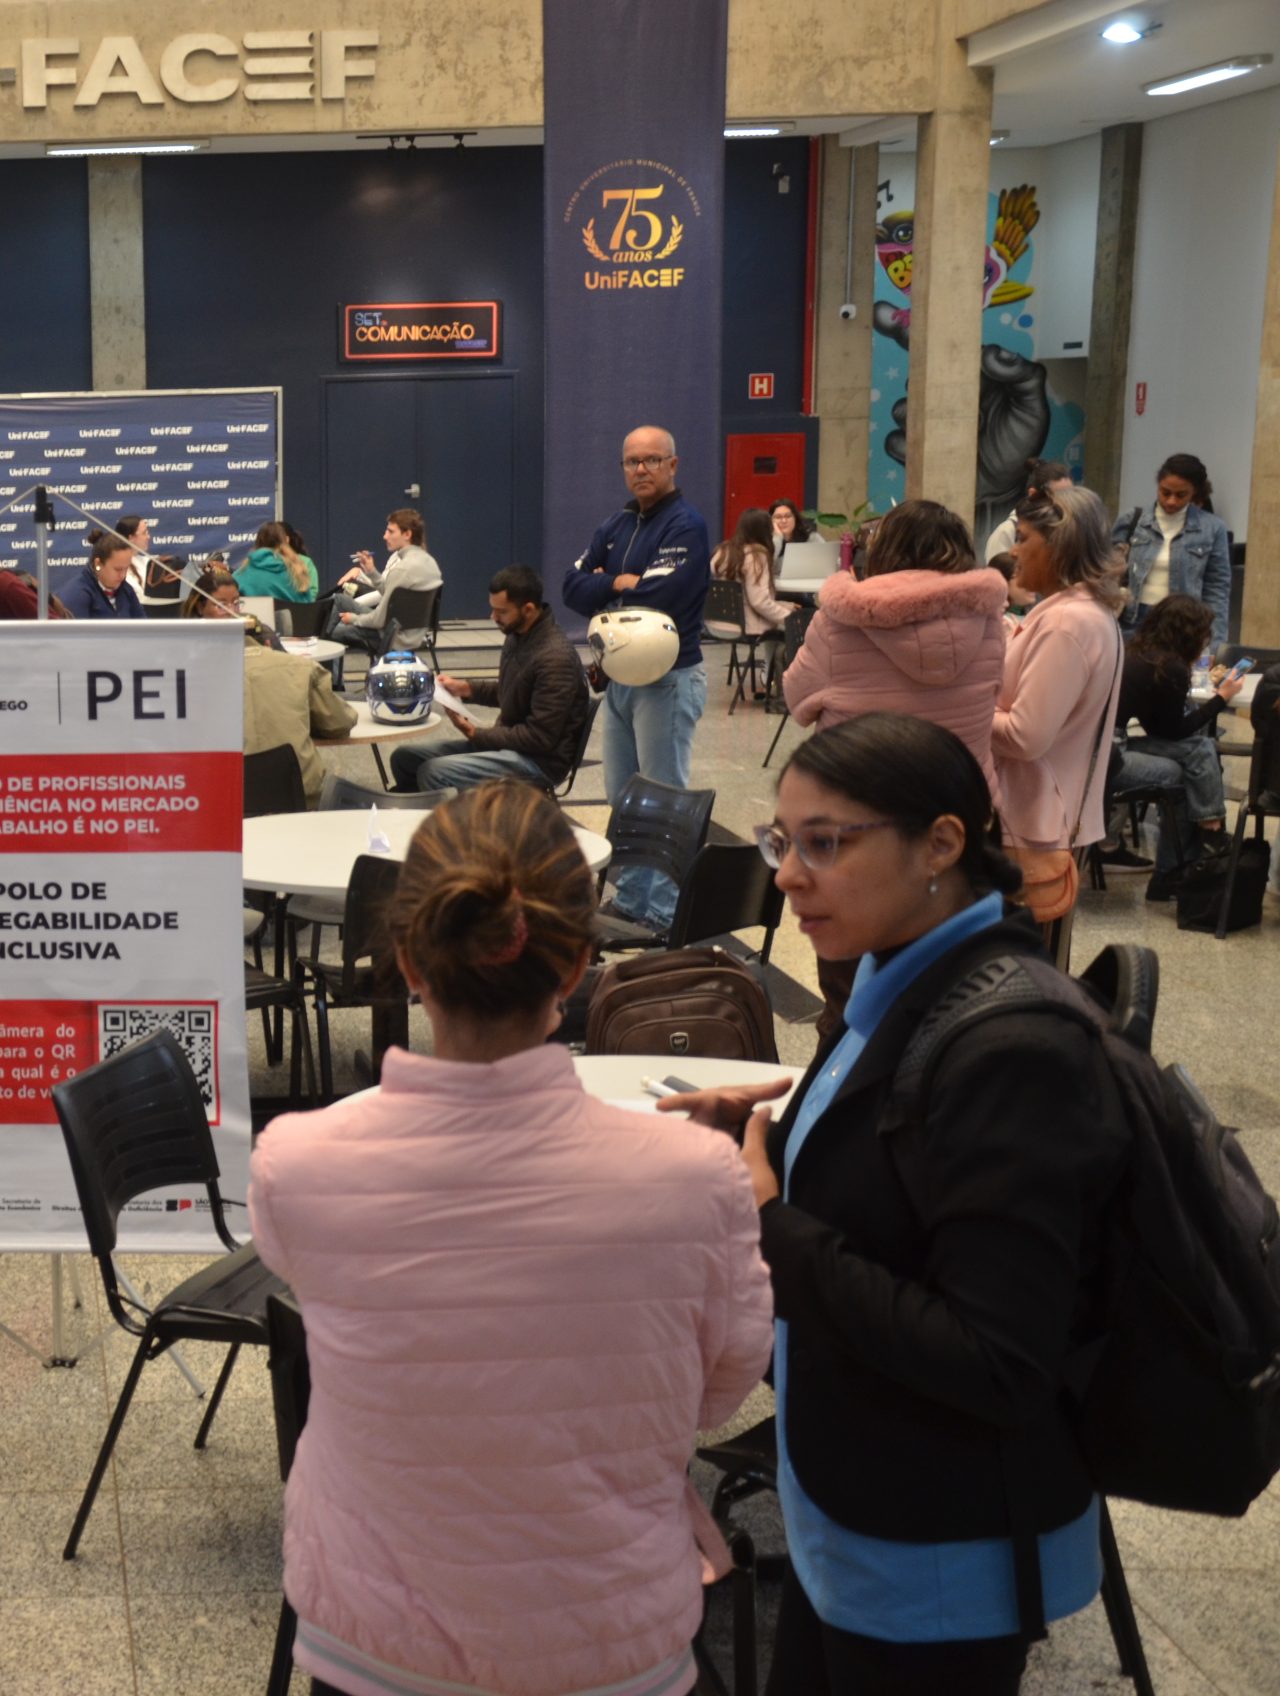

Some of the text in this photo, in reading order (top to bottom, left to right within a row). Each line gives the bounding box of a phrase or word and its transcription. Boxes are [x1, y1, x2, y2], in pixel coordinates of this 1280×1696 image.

[636, 159, 676, 177] MUNICIPAL
[603, 184, 662, 250] 75
[612, 251, 653, 262] anos
[585, 268, 684, 289] UniFACEF
[354, 312, 382, 326] SET
[355, 321, 475, 342] COMUNICAÇÃO
[754, 378, 768, 395] H
[87, 668, 187, 721] PEI
[7, 777, 33, 792] DE
[39, 775, 186, 792] PROFISSIONAIS
[67, 798, 96, 813] NO
[102, 796, 199, 812] MERCADO
[73, 816, 85, 834] É
[90, 819, 119, 833] NO
[124, 818, 160, 833] PEI.
[71, 882, 107, 900] DE
[56, 1024, 75, 1038] do
[34, 1047, 44, 1058] o
[51, 1044, 76, 1060] QR
[11, 1064, 43, 1081] qual
[50, 1064, 59, 1078] é
[67, 1067, 76, 1078] o
[18, 1085, 36, 1099] de
